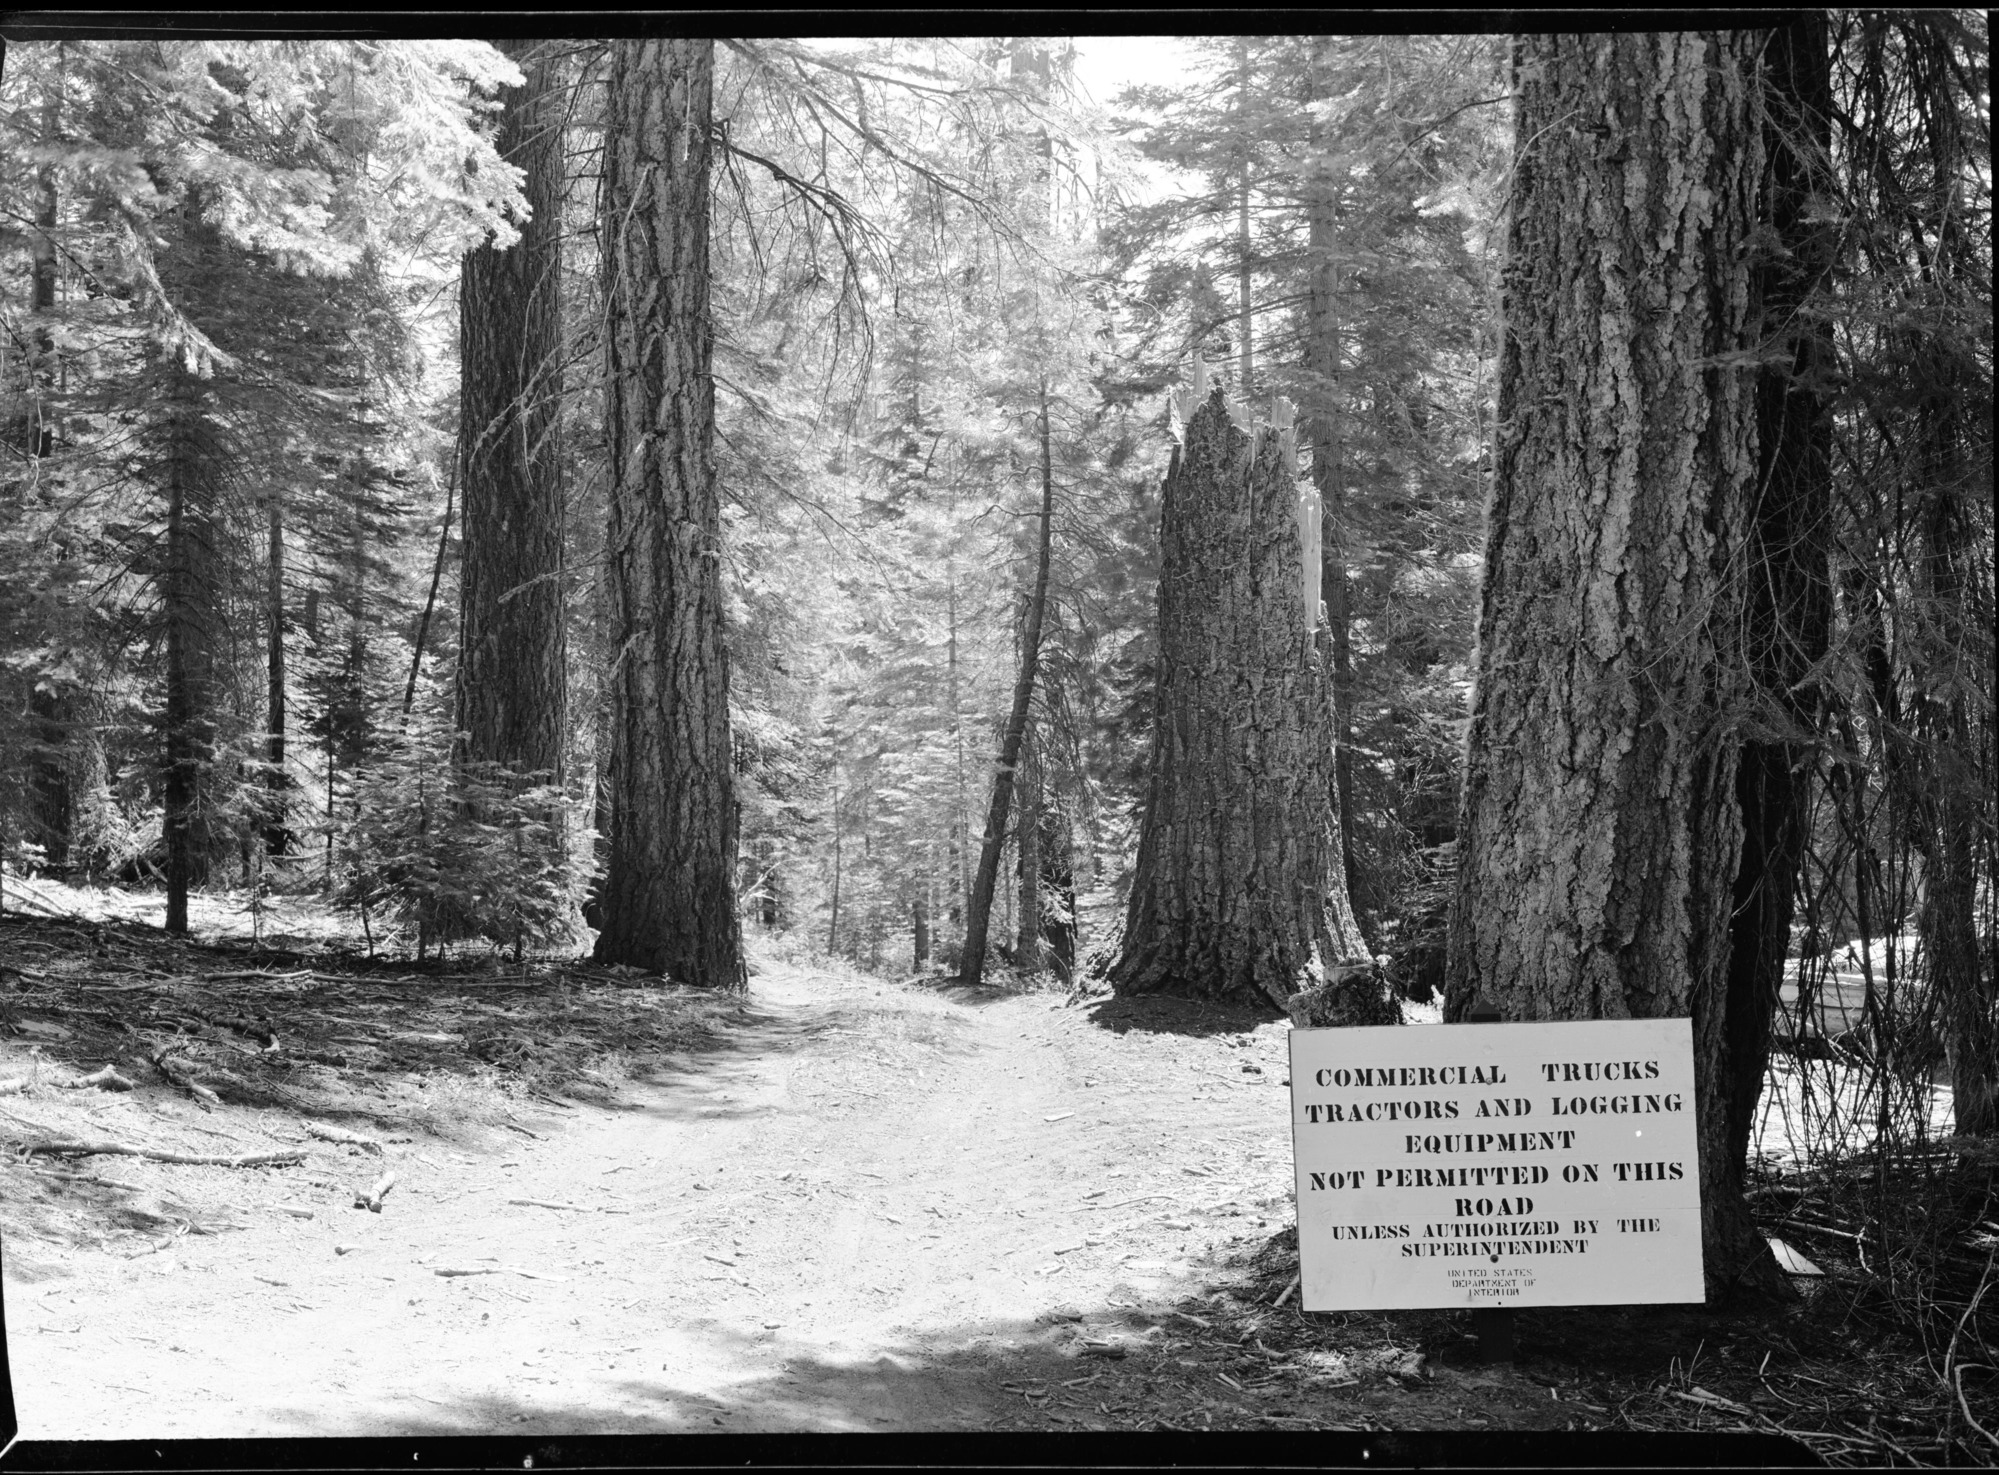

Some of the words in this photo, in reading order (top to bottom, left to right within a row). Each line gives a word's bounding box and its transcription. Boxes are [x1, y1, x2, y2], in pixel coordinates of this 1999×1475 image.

[1316, 1066, 1506, 1087] COMMERCIAL
[1542, 1061, 1659, 1082] TRUCKS
[1305, 1101, 1459, 1123] TRACTORS
[1475, 1098, 1531, 1117] AND
[1552, 1094, 1682, 1115] LOGGING
[1406, 1131, 1575, 1154] EQUIPMENT
[1309, 1171, 1364, 1191] NOT
[1376, 1166, 1548, 1187] PERMITTED
[1563, 1164, 1598, 1183] ON
[1613, 1162, 1683, 1181] THIS
[1455, 1197, 1533, 1216] ROAD
[1332, 1225, 1410, 1240] UNLESS
[1423, 1221, 1559, 1237] AUTHORIZED
[1574, 1220, 1598, 1234] BY
[1617, 1219, 1660, 1232] THE
[1402, 1240, 1588, 1257] SUPERINTENDENT
[1447, 1269, 1487, 1278] UNITED
[1493, 1268, 1533, 1277] STATES
[1452, 1279, 1517, 1288] DEPARTMENT
[1524, 1278, 1537, 1287] OF
[1468, 1288, 1520, 1297] INTERIOR
